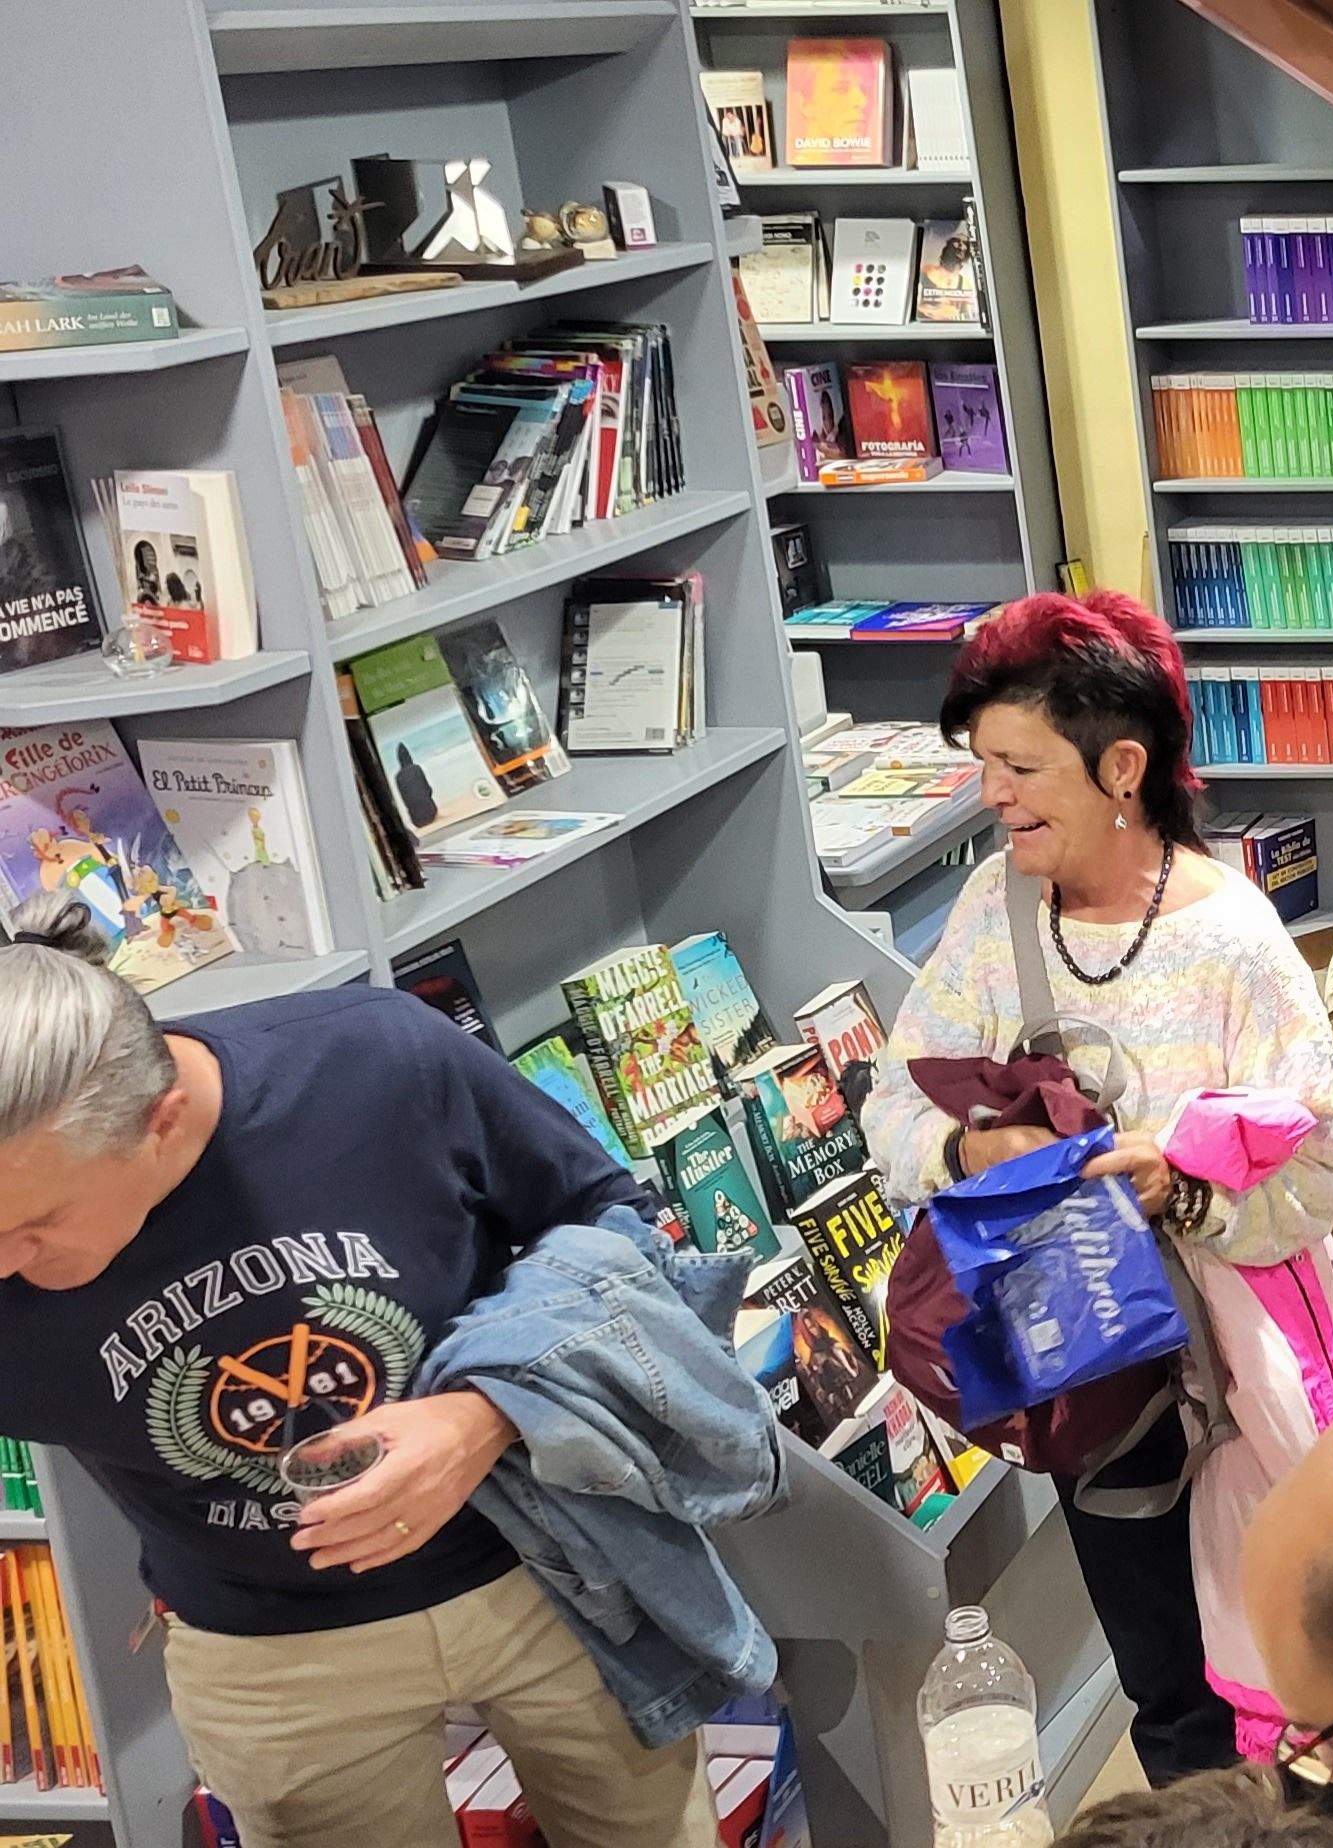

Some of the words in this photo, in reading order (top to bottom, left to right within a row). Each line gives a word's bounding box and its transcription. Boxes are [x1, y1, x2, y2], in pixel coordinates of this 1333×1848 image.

[795, 137, 830, 149] DAVID
[832, 137, 872, 149] BOWIE
[35, 316, 86, 332] LARK
[811, 369, 832, 386] CINE
[861, 440, 926, 452] FOTOGRAFÍA
[7, 601, 30, 617] VIE
[31, 593, 56, 610] N'A
[57, 587, 84, 604] PAS
[0, 603, 89, 642] OMMENCÉ
[5, 742, 52, 770] Fille
[58, 731, 84, 751] de
[153, 770, 171, 791] El
[175, 769, 211, 793] Petit
[1277, 854, 1293, 867] TEST
[596, 949, 668, 1001] MAGGIE
[598, 981, 690, 1041] O'FARRELL
[701, 999, 755, 1035] SISTER
[571, 985, 597, 1034] MAGGIE
[586, 1037, 619, 1099] O'FARRELL
[803, 1026, 819, 1044] PO
[827, 1018, 883, 1074] PONY
[638, 1052, 663, 1078] THE
[627, 1057, 718, 1124] MARRIAGE
[686, 1149, 709, 1168] The
[788, 1130, 855, 1179] MEMORY
[797, 1138, 815, 1155] THE
[680, 1145, 733, 1190] Hustler
[813, 1158, 845, 1186] BOX
[799, 1217, 830, 1257] FIVE
[826, 1190, 893, 1259] FIVE
[763, 1272, 795, 1300] PETER
[100, 1231, 400, 1401] ARIZONA
[842, 1305, 871, 1349] JACKSON
[852, 1307, 876, 1339] HOLLY
[230, 1398, 276, 1432] 19
[308, 1361, 359, 1394] 81
[857, 1468, 888, 1491] EEL
